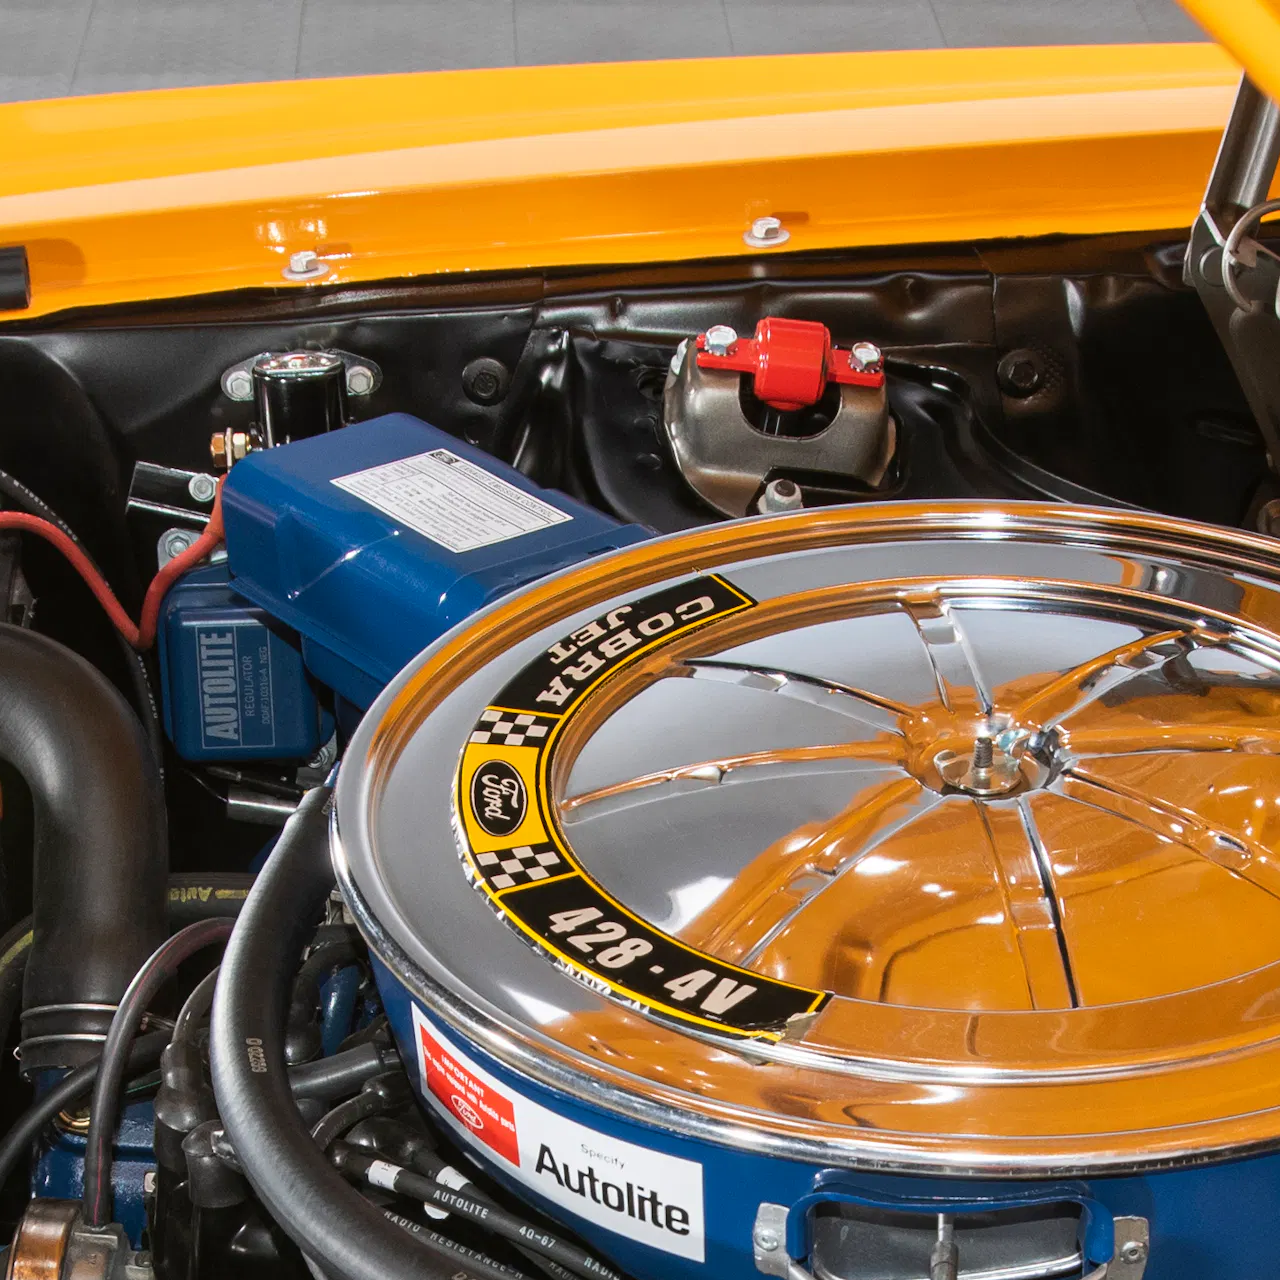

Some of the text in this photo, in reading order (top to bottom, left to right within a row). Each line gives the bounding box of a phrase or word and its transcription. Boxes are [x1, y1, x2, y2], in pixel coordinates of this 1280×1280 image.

[258, 646, 268, 664] NEG
[535, 595, 715, 706] COBRA
[547, 605, 632, 665] JET
[199, 632, 239, 741] AUTOLITE
[241, 655, 255, 717] REGULATOR
[481, 773, 518, 822] Ford
[441, 1054, 484, 1097] IMPORTANT
[581, 1143, 625, 1170] Specify
[433, 1189, 489, 1220] AUTOLITE
[535, 1143, 690, 1236] Autolite
[383, 1211, 421, 1233] RADIO
